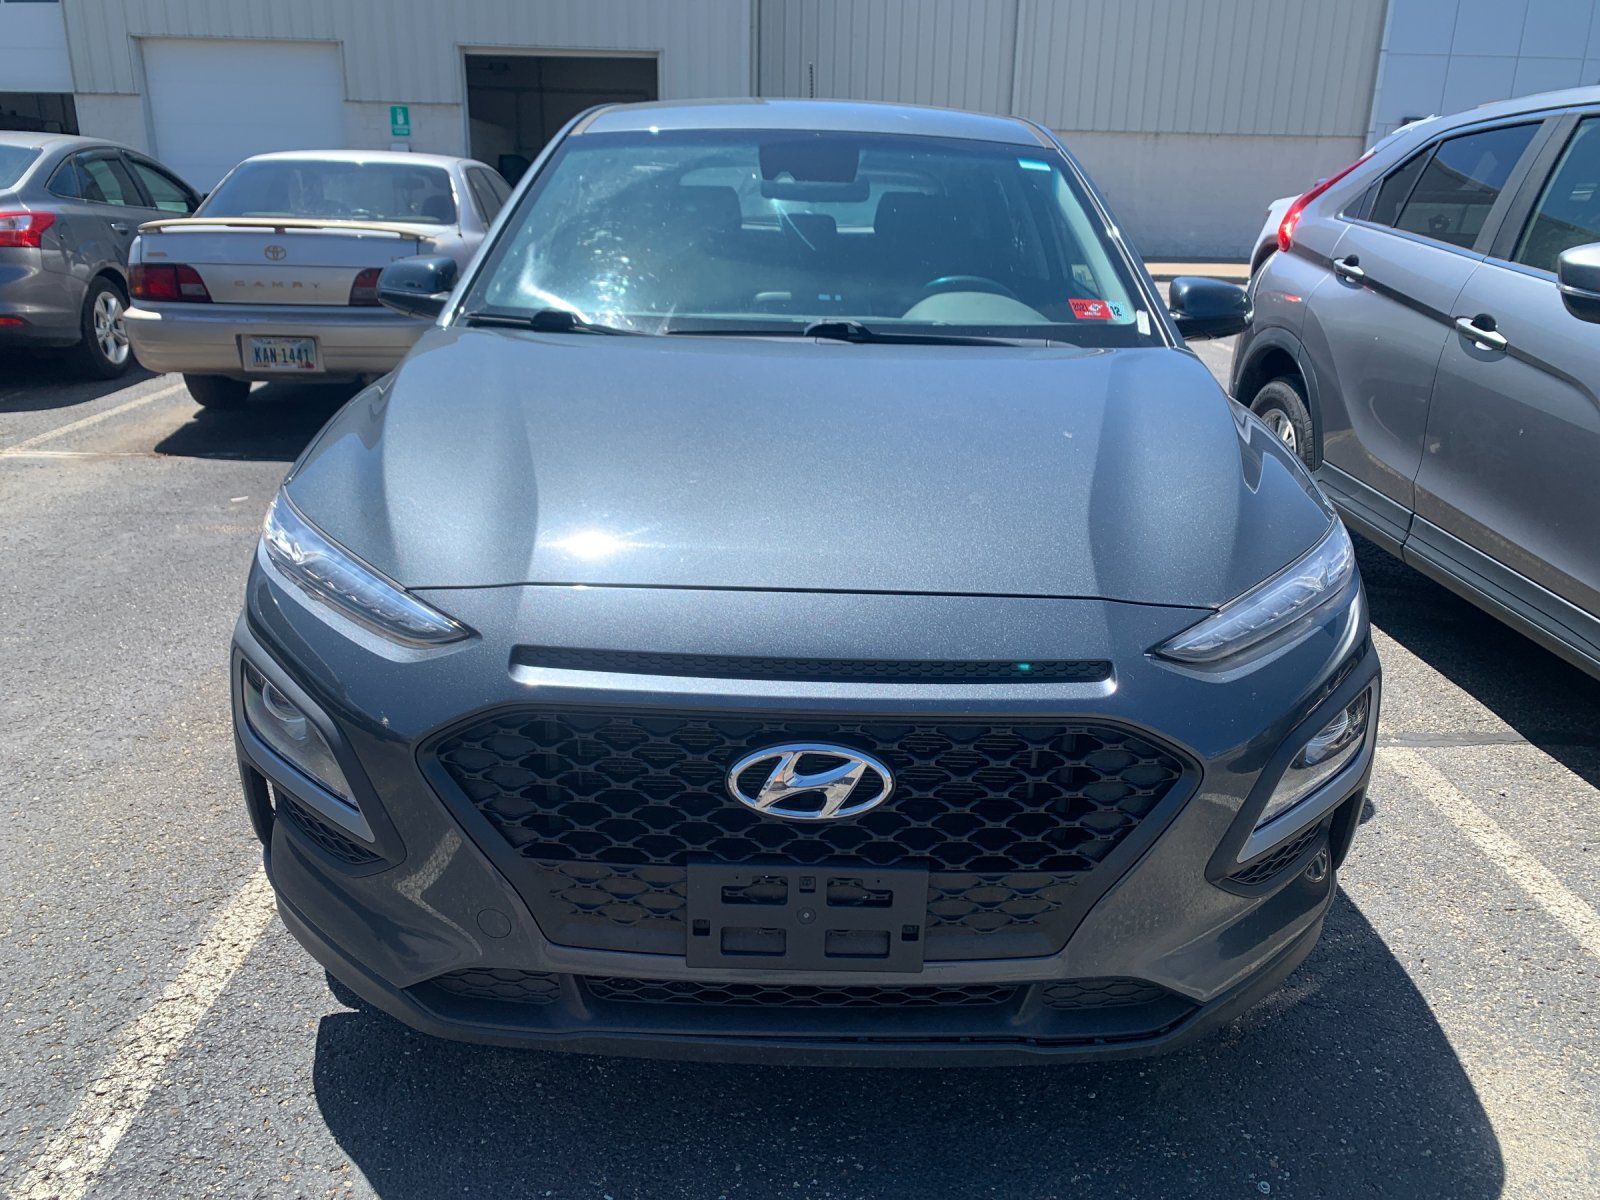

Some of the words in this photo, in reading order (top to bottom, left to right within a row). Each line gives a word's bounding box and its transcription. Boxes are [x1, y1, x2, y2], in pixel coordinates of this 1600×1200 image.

[234, 280, 320, 289] CAMRY
[1110, 306, 1122, 317] 12
[254, 347, 277, 363] KAN
[281, 348, 309, 364] 1441
